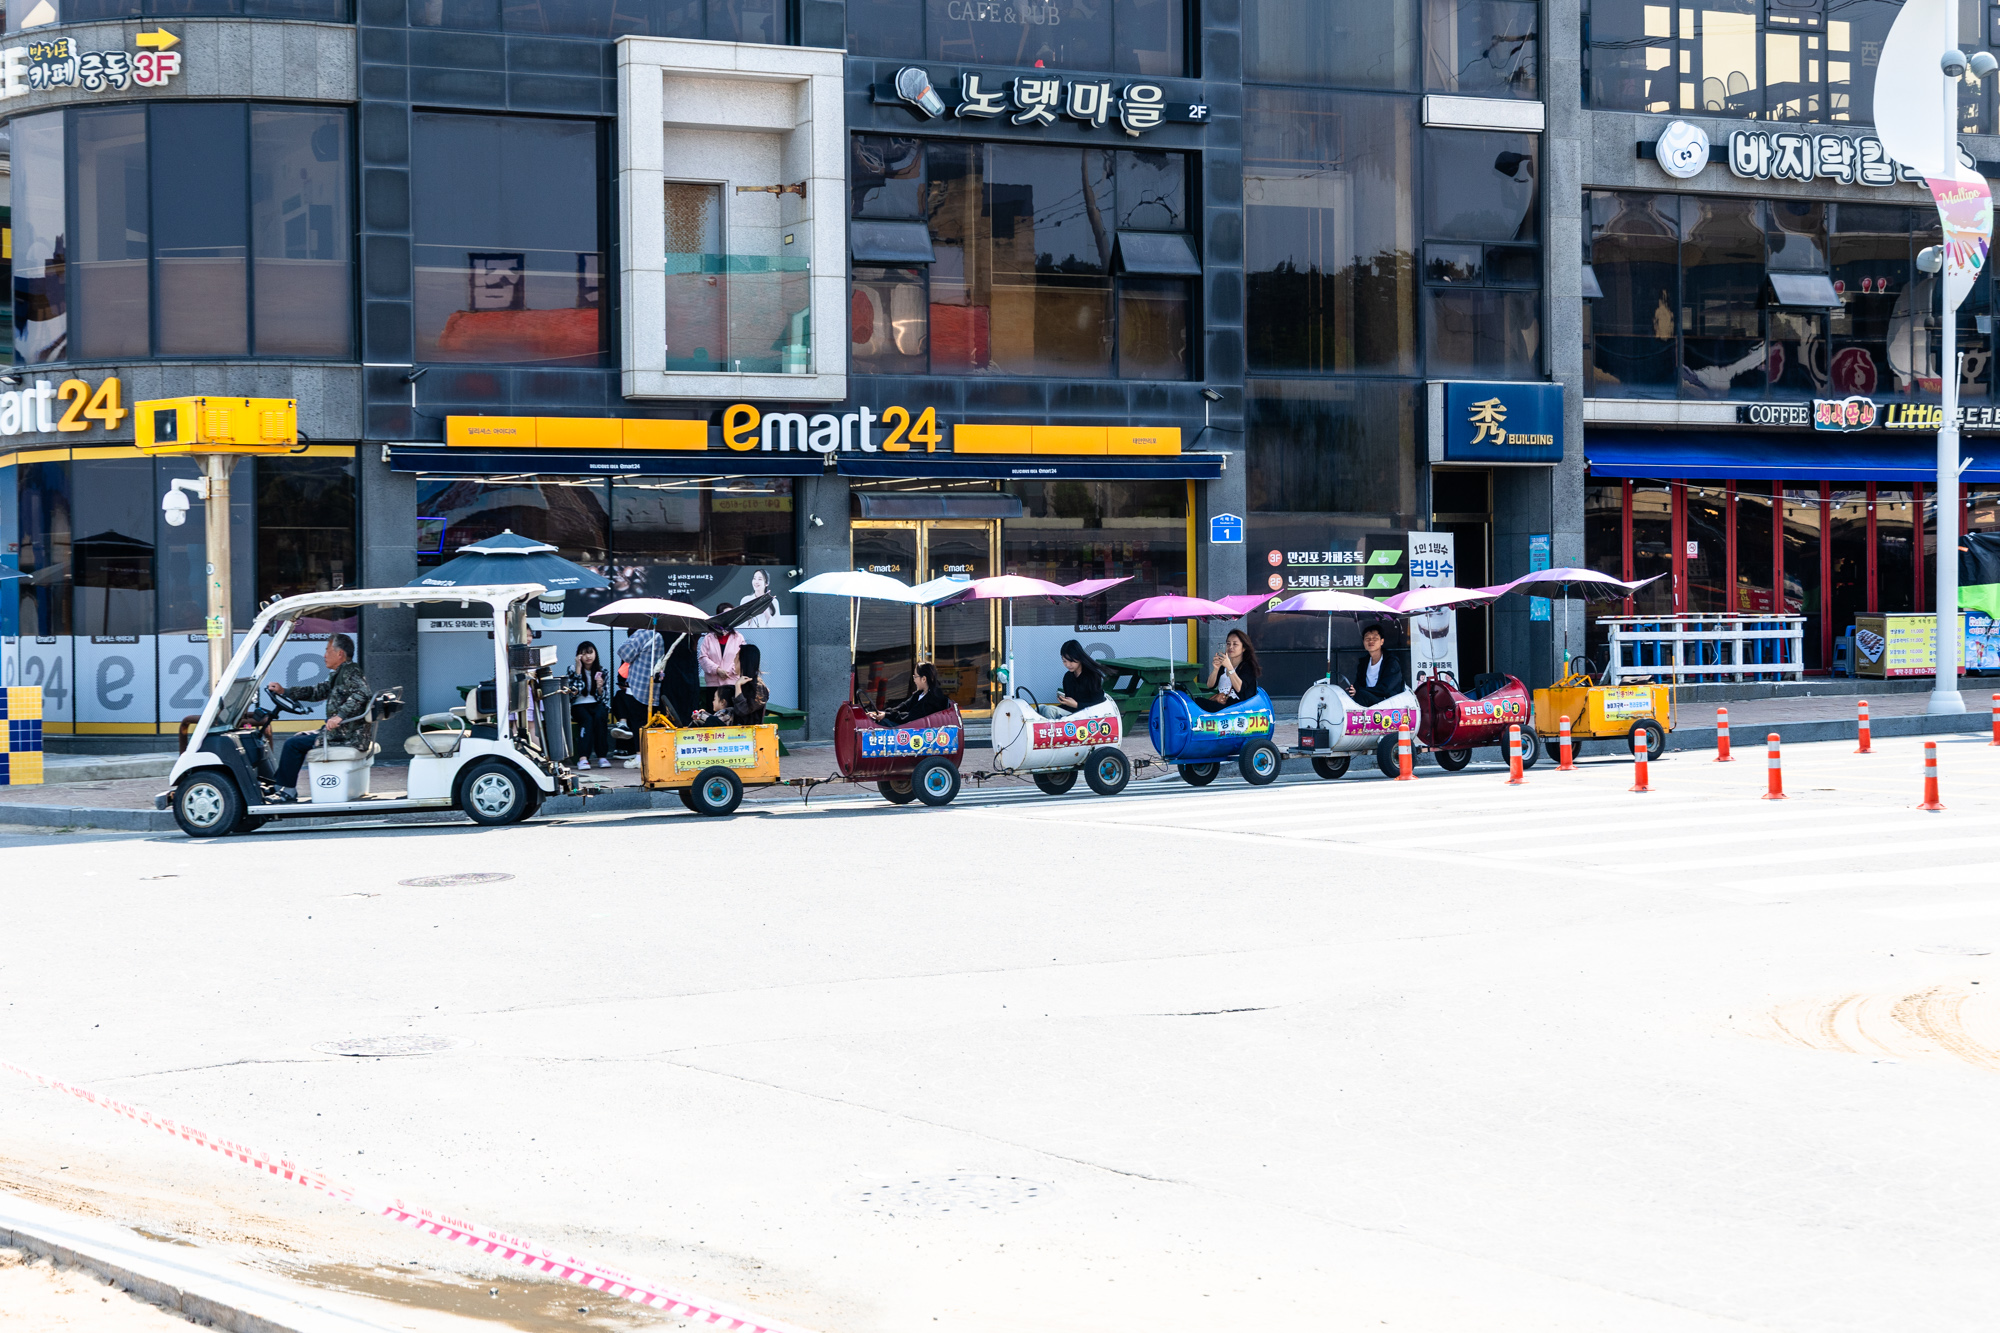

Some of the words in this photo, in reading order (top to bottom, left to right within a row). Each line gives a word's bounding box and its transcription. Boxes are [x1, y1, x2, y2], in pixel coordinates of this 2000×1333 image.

[947, 0, 1001, 22] CAFE
[1004, 6, 1016, 24] &
[1020, 4, 1060, 26] PUB
[29, 41, 69, 61] 만리포
[0, 46, 30, 98] E
[135, 54, 176, 83] 3F
[960, 74, 1165, 130] 노랫마을
[1189, 105, 1207, 118] 2F
[1732, 131, 1976, 190] 바지락칼
[1939, 187, 1980, 207] Mallipo
[1750, 405, 1809, 423] COFFEE
[1888, 404, 1943, 428] Little
[1468, 397, 1508, 445] 秀
[723, 404, 943, 453] emart24
[1508, 434, 1554, 445] BUILDING
[1223, 528, 1230, 539] 1
[1414, 544, 1426, 555] 1인
[1287, 551, 1319, 563] 만리포
[1322, 551, 1363, 563] 카페중독
[869, 564, 900, 572] emart24
[943, 564, 974, 572] emart24
[1410, 559, 1453, 577] 컵빙수
[1288, 575, 1330, 587] 노랫마을
[1333, 575, 1364, 587] 노래방
[1464, 706, 1484, 715] 만리포
[1351, 715, 1371, 725] 만리포
[1039, 727, 1063, 739] 만리포
[869, 735, 895, 746] 만리포
[321, 777, 337, 785] 228
